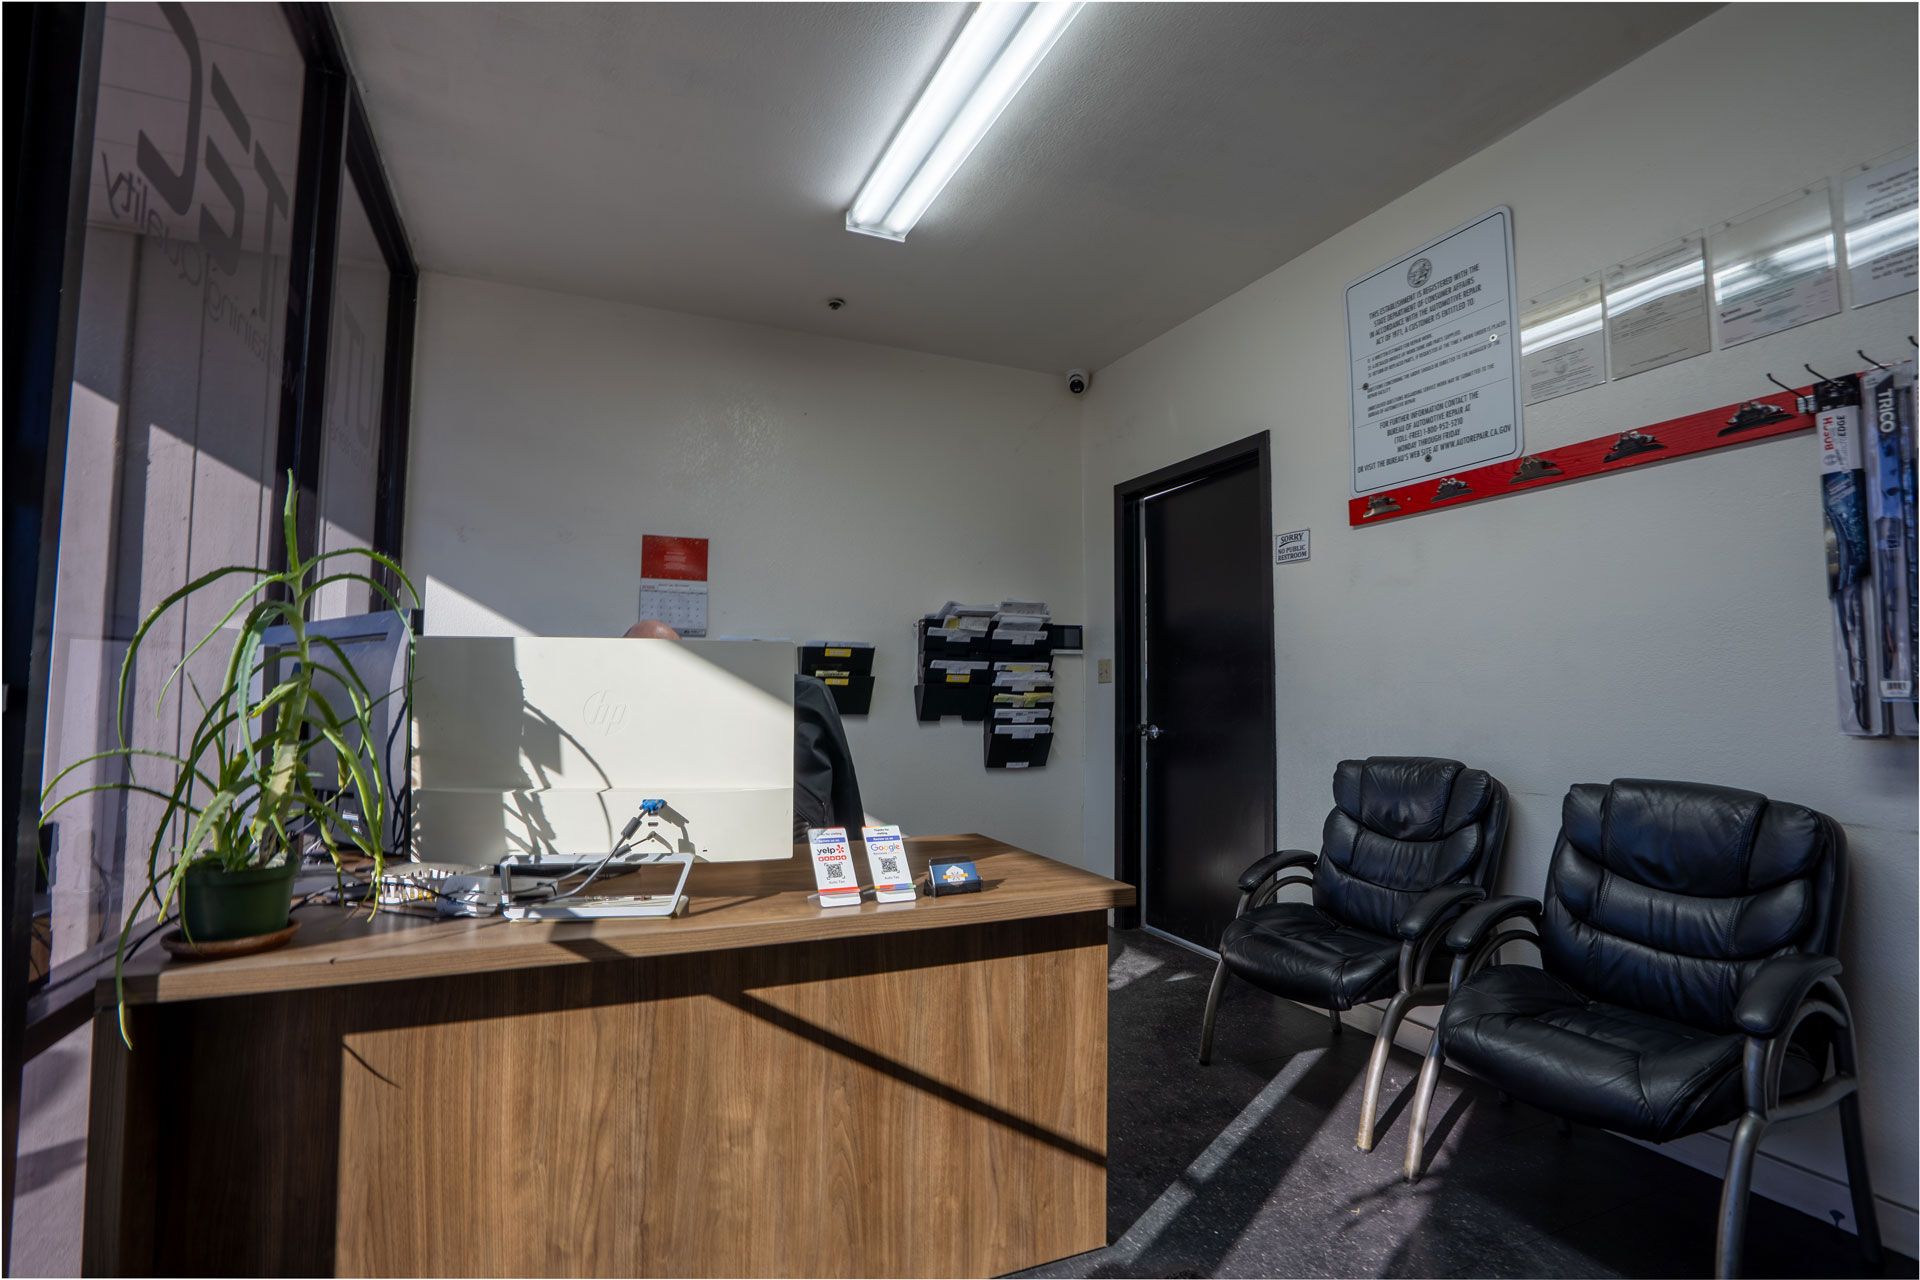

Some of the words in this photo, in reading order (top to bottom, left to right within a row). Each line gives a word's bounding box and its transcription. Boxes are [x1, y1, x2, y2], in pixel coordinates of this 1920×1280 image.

[1368, 309, 1378, 319] THIS
[1379, 292, 1415, 314] ESTABLISHMENT
[1416, 289, 1421, 298] IS
[1422, 275, 1452, 295] REGISTERED
[1453, 268, 1467, 281] WITH
[1469, 263, 1479, 274] THE
[1373, 315, 1386, 327] STATE
[1387, 302, 1416, 321] DEPARTMENT
[1417, 298, 1423, 307] OF
[1424, 286, 1451, 304] CONSUMER
[1452, 276, 1474, 292] AFFAIRS
[1369, 330, 1374, 338] IN
[1375, 317, 1404, 336] ACCORDANCE
[1405, 311, 1417, 323] WITH
[1418, 307, 1428, 317] THE
[1429, 292, 1461, 313] AUTOMOTIVE
[1462, 283, 1482, 298] REPAIR
[1375, 335, 1384, 345] ACT
[1384, 332, 1391, 341] OF
[1404, 325, 1407, 333] A
[1408, 314, 1434, 331] CUSTOMER
[1435, 311, 1440, 320] IS
[1441, 301, 1465, 317] ENTITLED
[1379, 420, 1388, 429] FOR
[1389, 413, 1409, 426] FURTHER
[1410, 402, 1443, 419] INFORMATION
[1444, 394, 1467, 408] CONTACT
[1468, 390, 1479, 400] THE
[1387, 424, 1404, 436] BUREAU
[1405, 422, 1412, 430] OF
[1413, 412, 1444, 428] AUTOMOTIVE
[1445, 406, 1463, 418] REPAIR
[1464, 403, 1470, 412] AT
[1878, 388, 1896, 433] TRICO
[1396, 441, 1416, 452] MONDAY
[1417, 433, 1441, 446] THROUGH
[1442, 428, 1460, 439] FRIDAY
[1823, 416, 1834, 451] BOSCH
[1357, 465, 1363, 473] OR
[1364, 462, 1375, 471] VISIT
[1376, 459, 1385, 468] THE
[1409, 449, 1419, 458] WEB
[1420, 446, 1431, 455] SITE
[1432, 444, 1439, 452] AT
[1280, 532, 1304, 544] SORRY
[1286, 544, 1306, 553] PUBLIC
[1278, 551, 1307, 561] RESTROOM
[817, 846, 836, 856] yelp
[870, 842, 900, 852] Google
